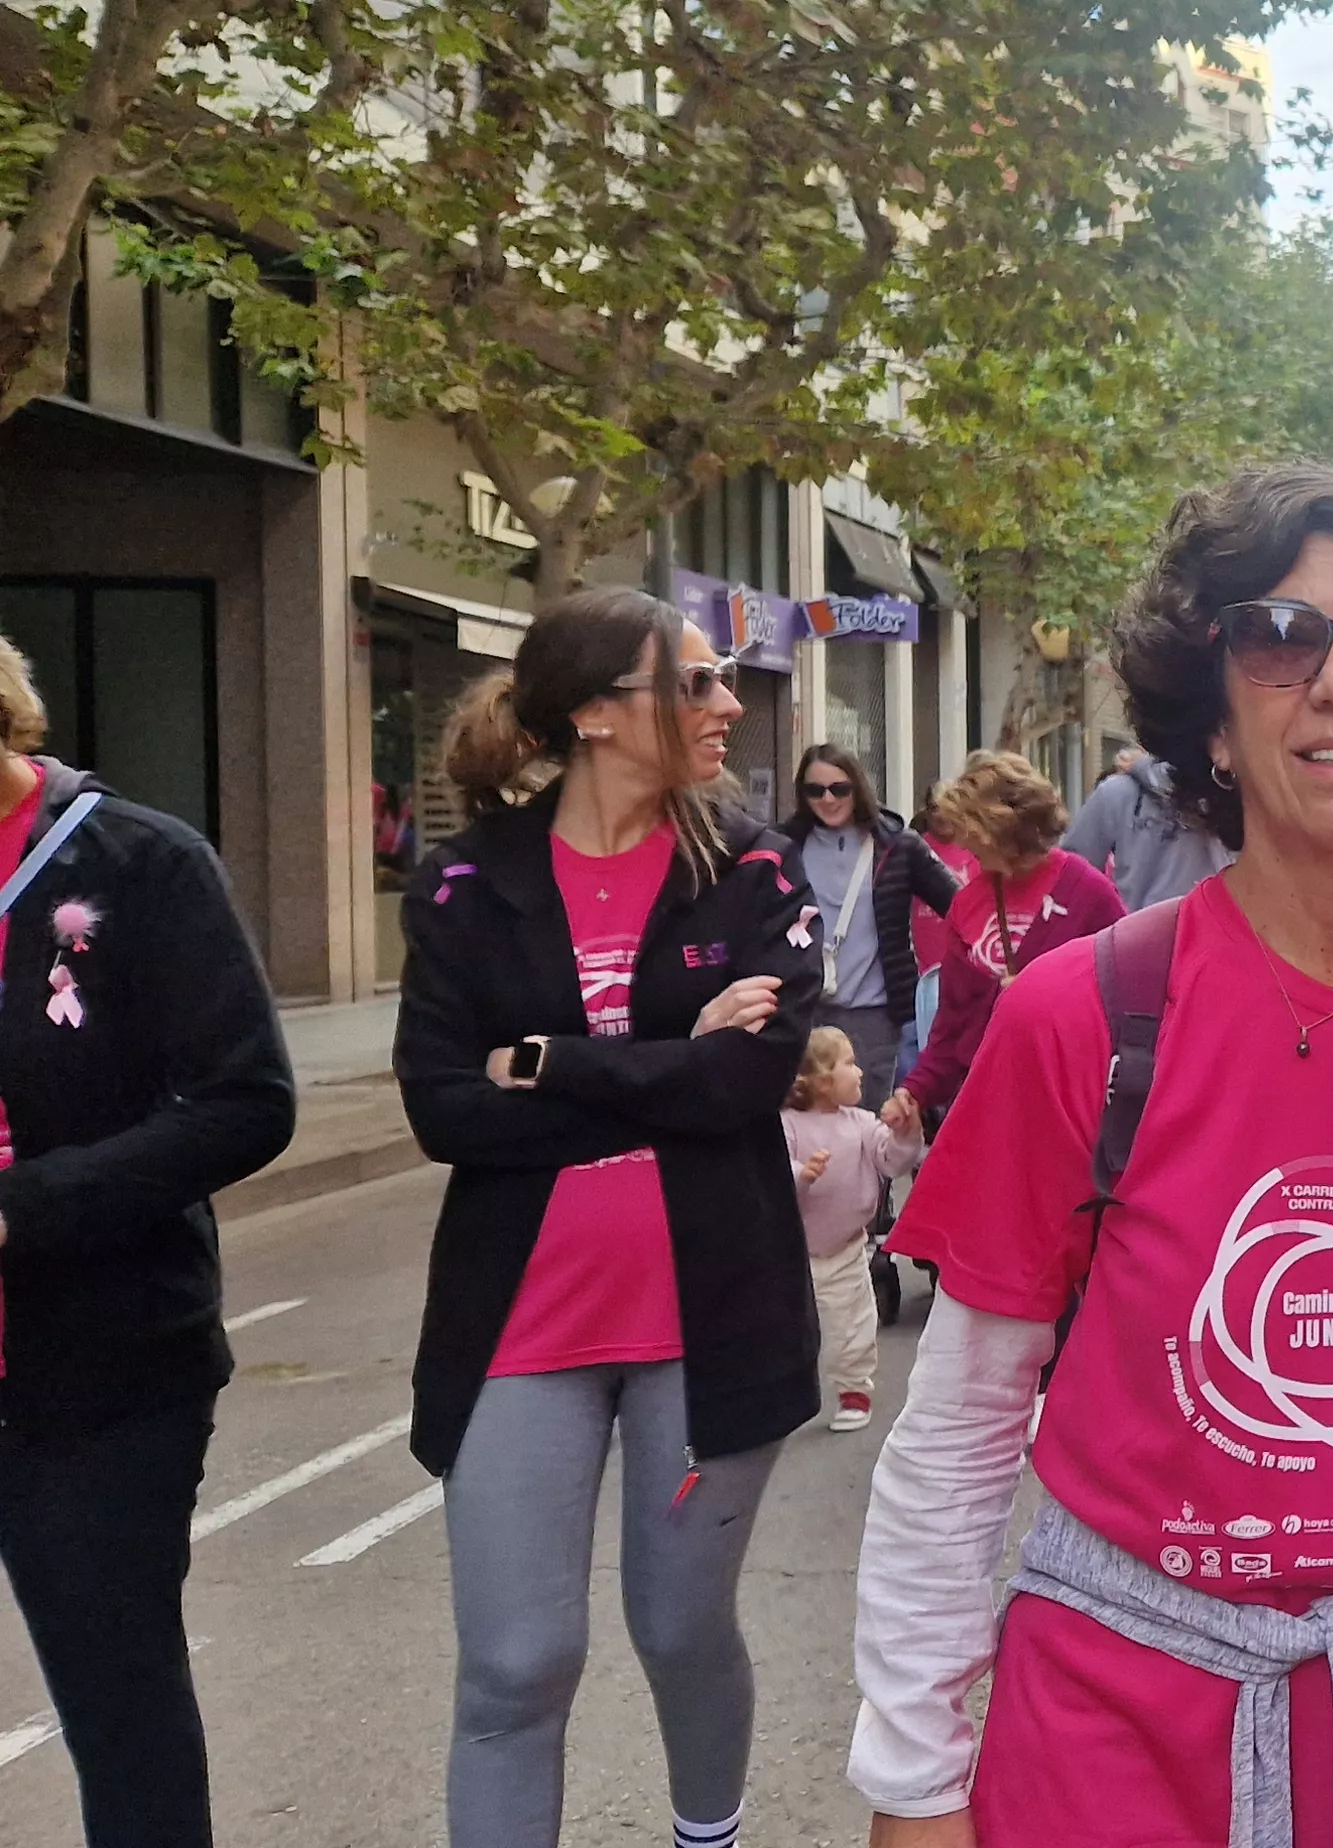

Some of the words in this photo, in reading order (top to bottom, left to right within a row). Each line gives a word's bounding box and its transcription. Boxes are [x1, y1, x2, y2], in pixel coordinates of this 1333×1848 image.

[829, 602, 906, 633] Folder
[1281, 1185, 1291, 1196] X
[1164, 1336, 1178, 1351] Te
[1167, 1352, 1196, 1423] acompaño,
[1192, 1414, 1210, 1433] Te
[1205, 1427, 1258, 1467] escucho,
[1261, 1451, 1276, 1467] Te
[1277, 1455, 1316, 1472] apoyo
[1162, 1517, 1215, 1534] podoactiva
[1231, 1523, 1268, 1534] Ferrer
[1304, 1518, 1330, 1529] hoya
